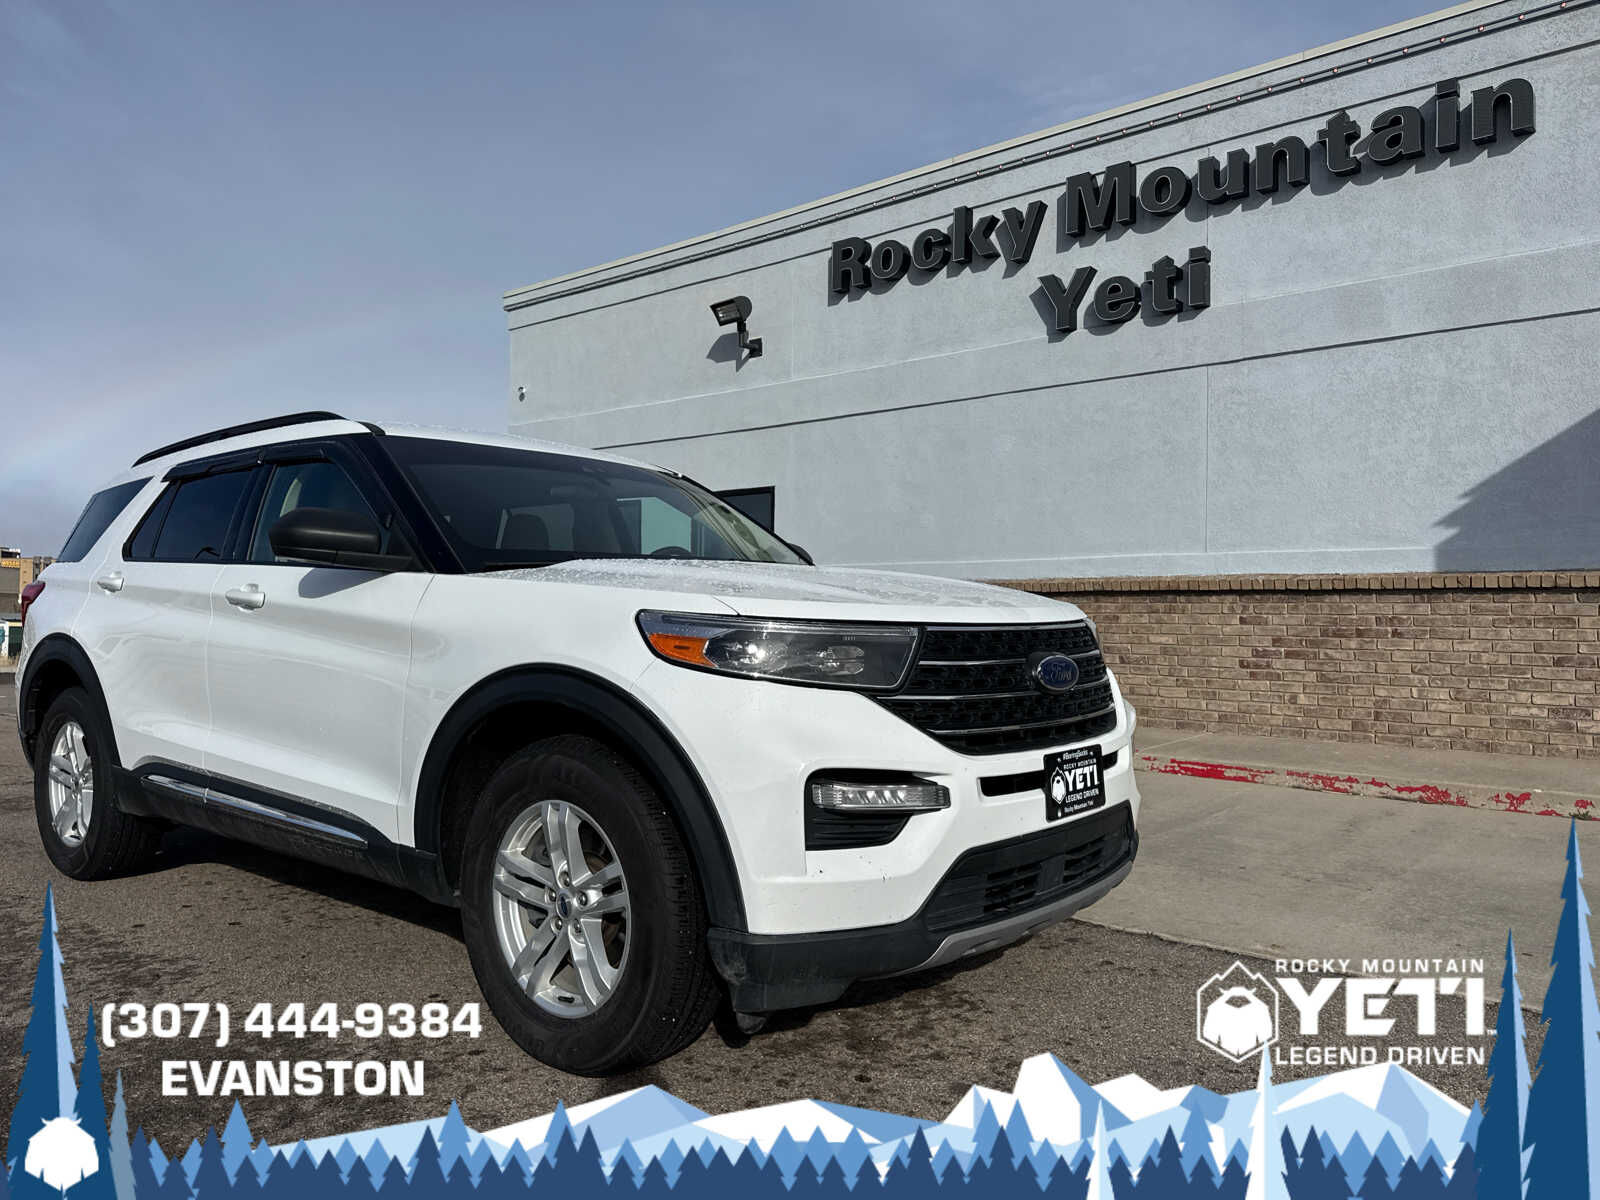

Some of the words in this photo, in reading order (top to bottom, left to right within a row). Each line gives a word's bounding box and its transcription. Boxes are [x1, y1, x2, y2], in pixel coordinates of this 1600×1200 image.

[831, 199, 1047, 293] Rocky
[1066, 77, 1536, 237] Mountain
[1039, 246, 1211, 332] Yeti
[1064, 765, 1098, 791] YETI
[1065, 793, 1083, 803] LEGEND
